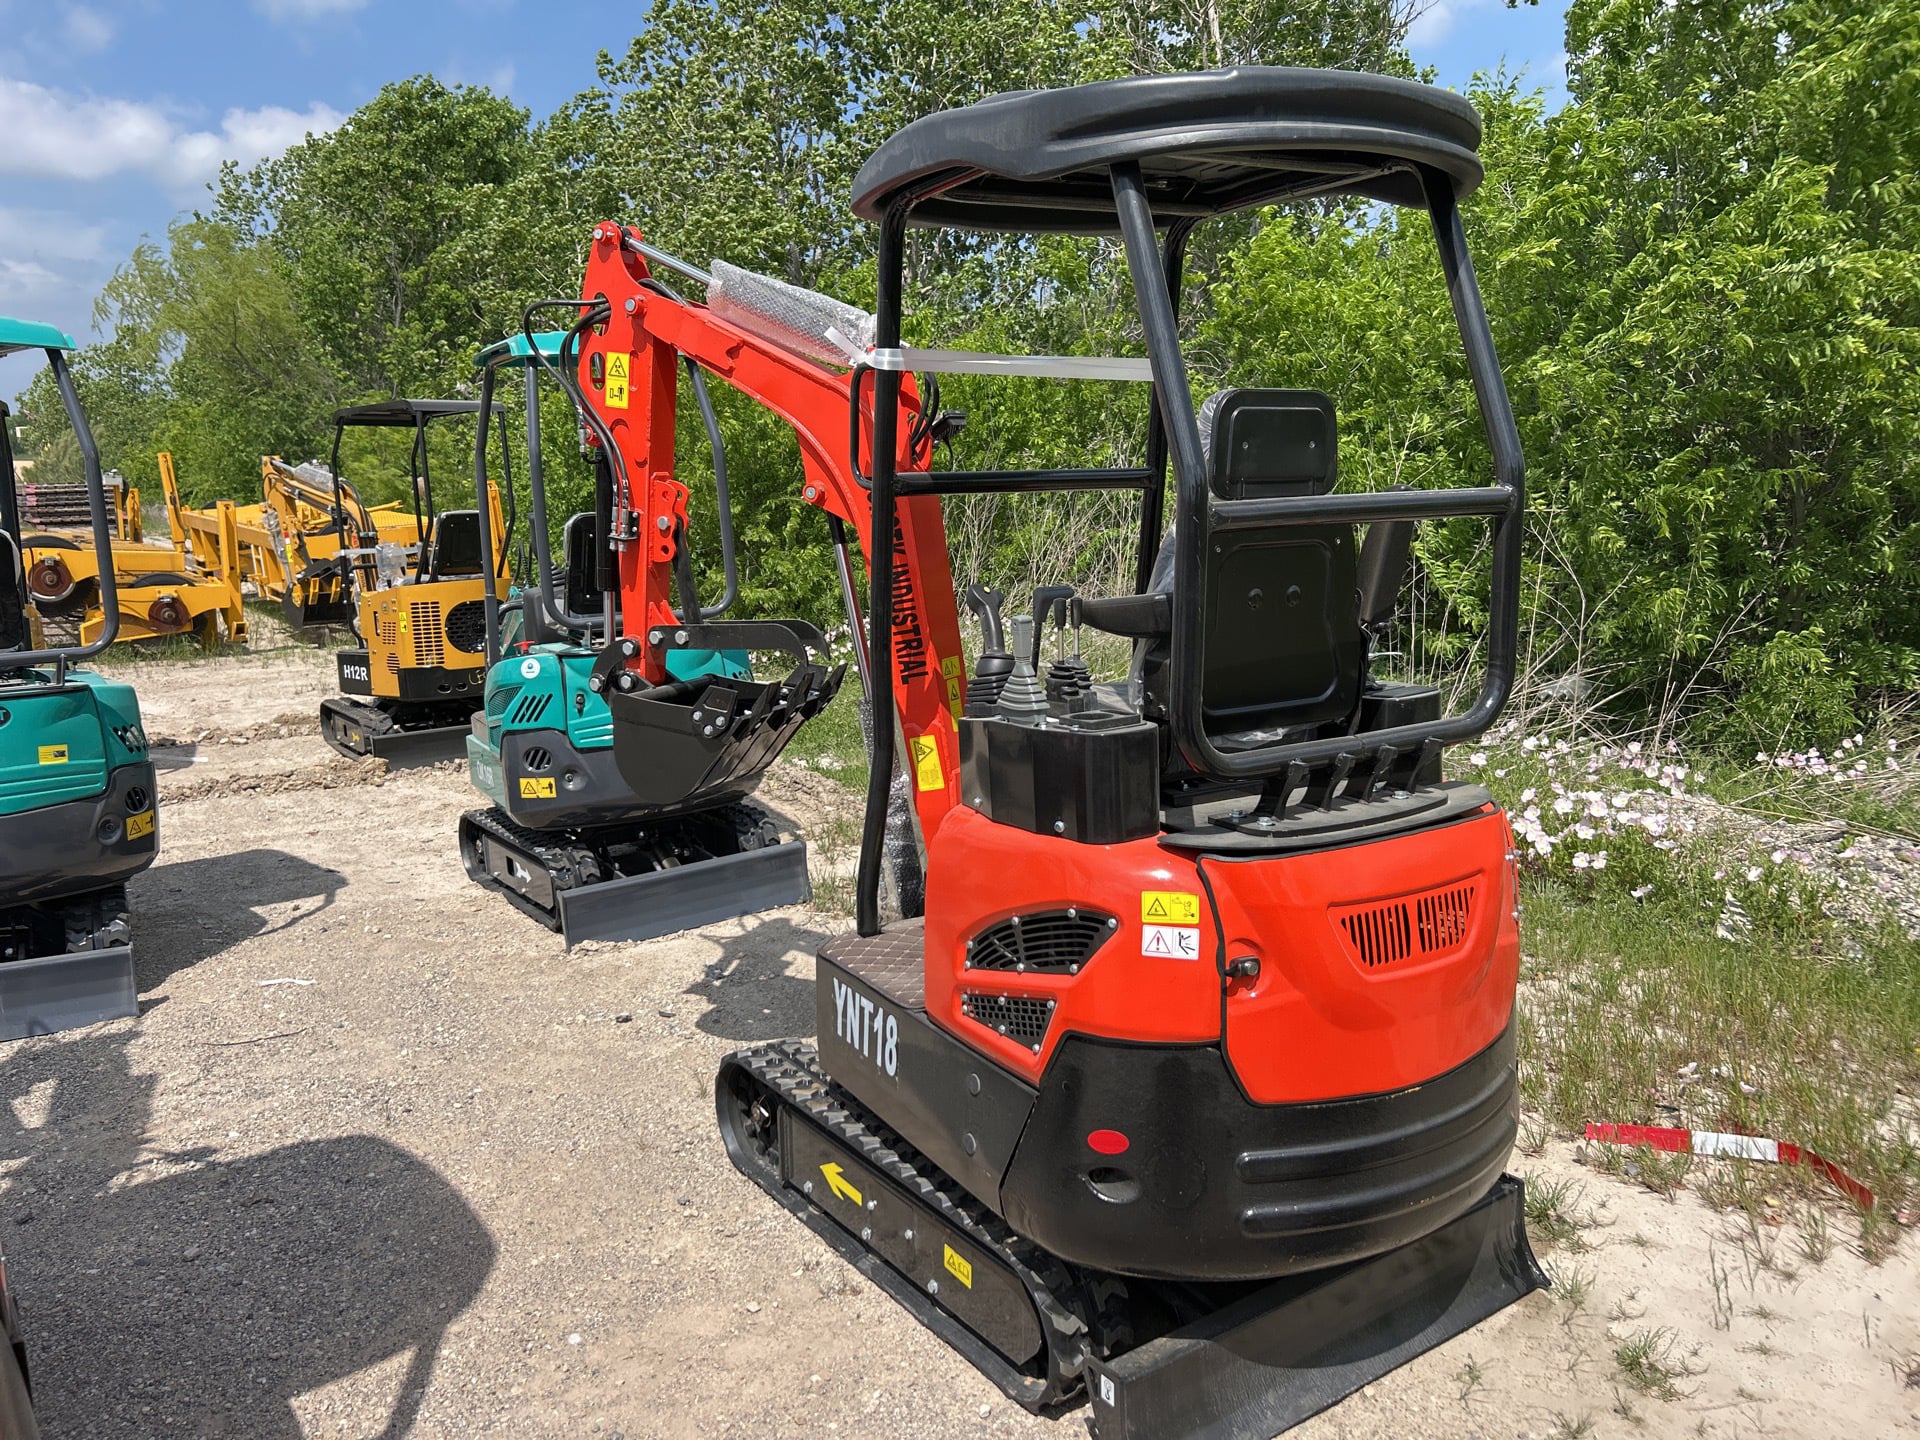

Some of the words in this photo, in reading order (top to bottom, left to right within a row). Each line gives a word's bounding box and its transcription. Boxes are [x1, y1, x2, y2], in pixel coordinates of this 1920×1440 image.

[343, 664, 369, 681] H12R
[891, 564, 929, 685] INDUSTRIAL
[833, 977, 898, 1077] YNT18
